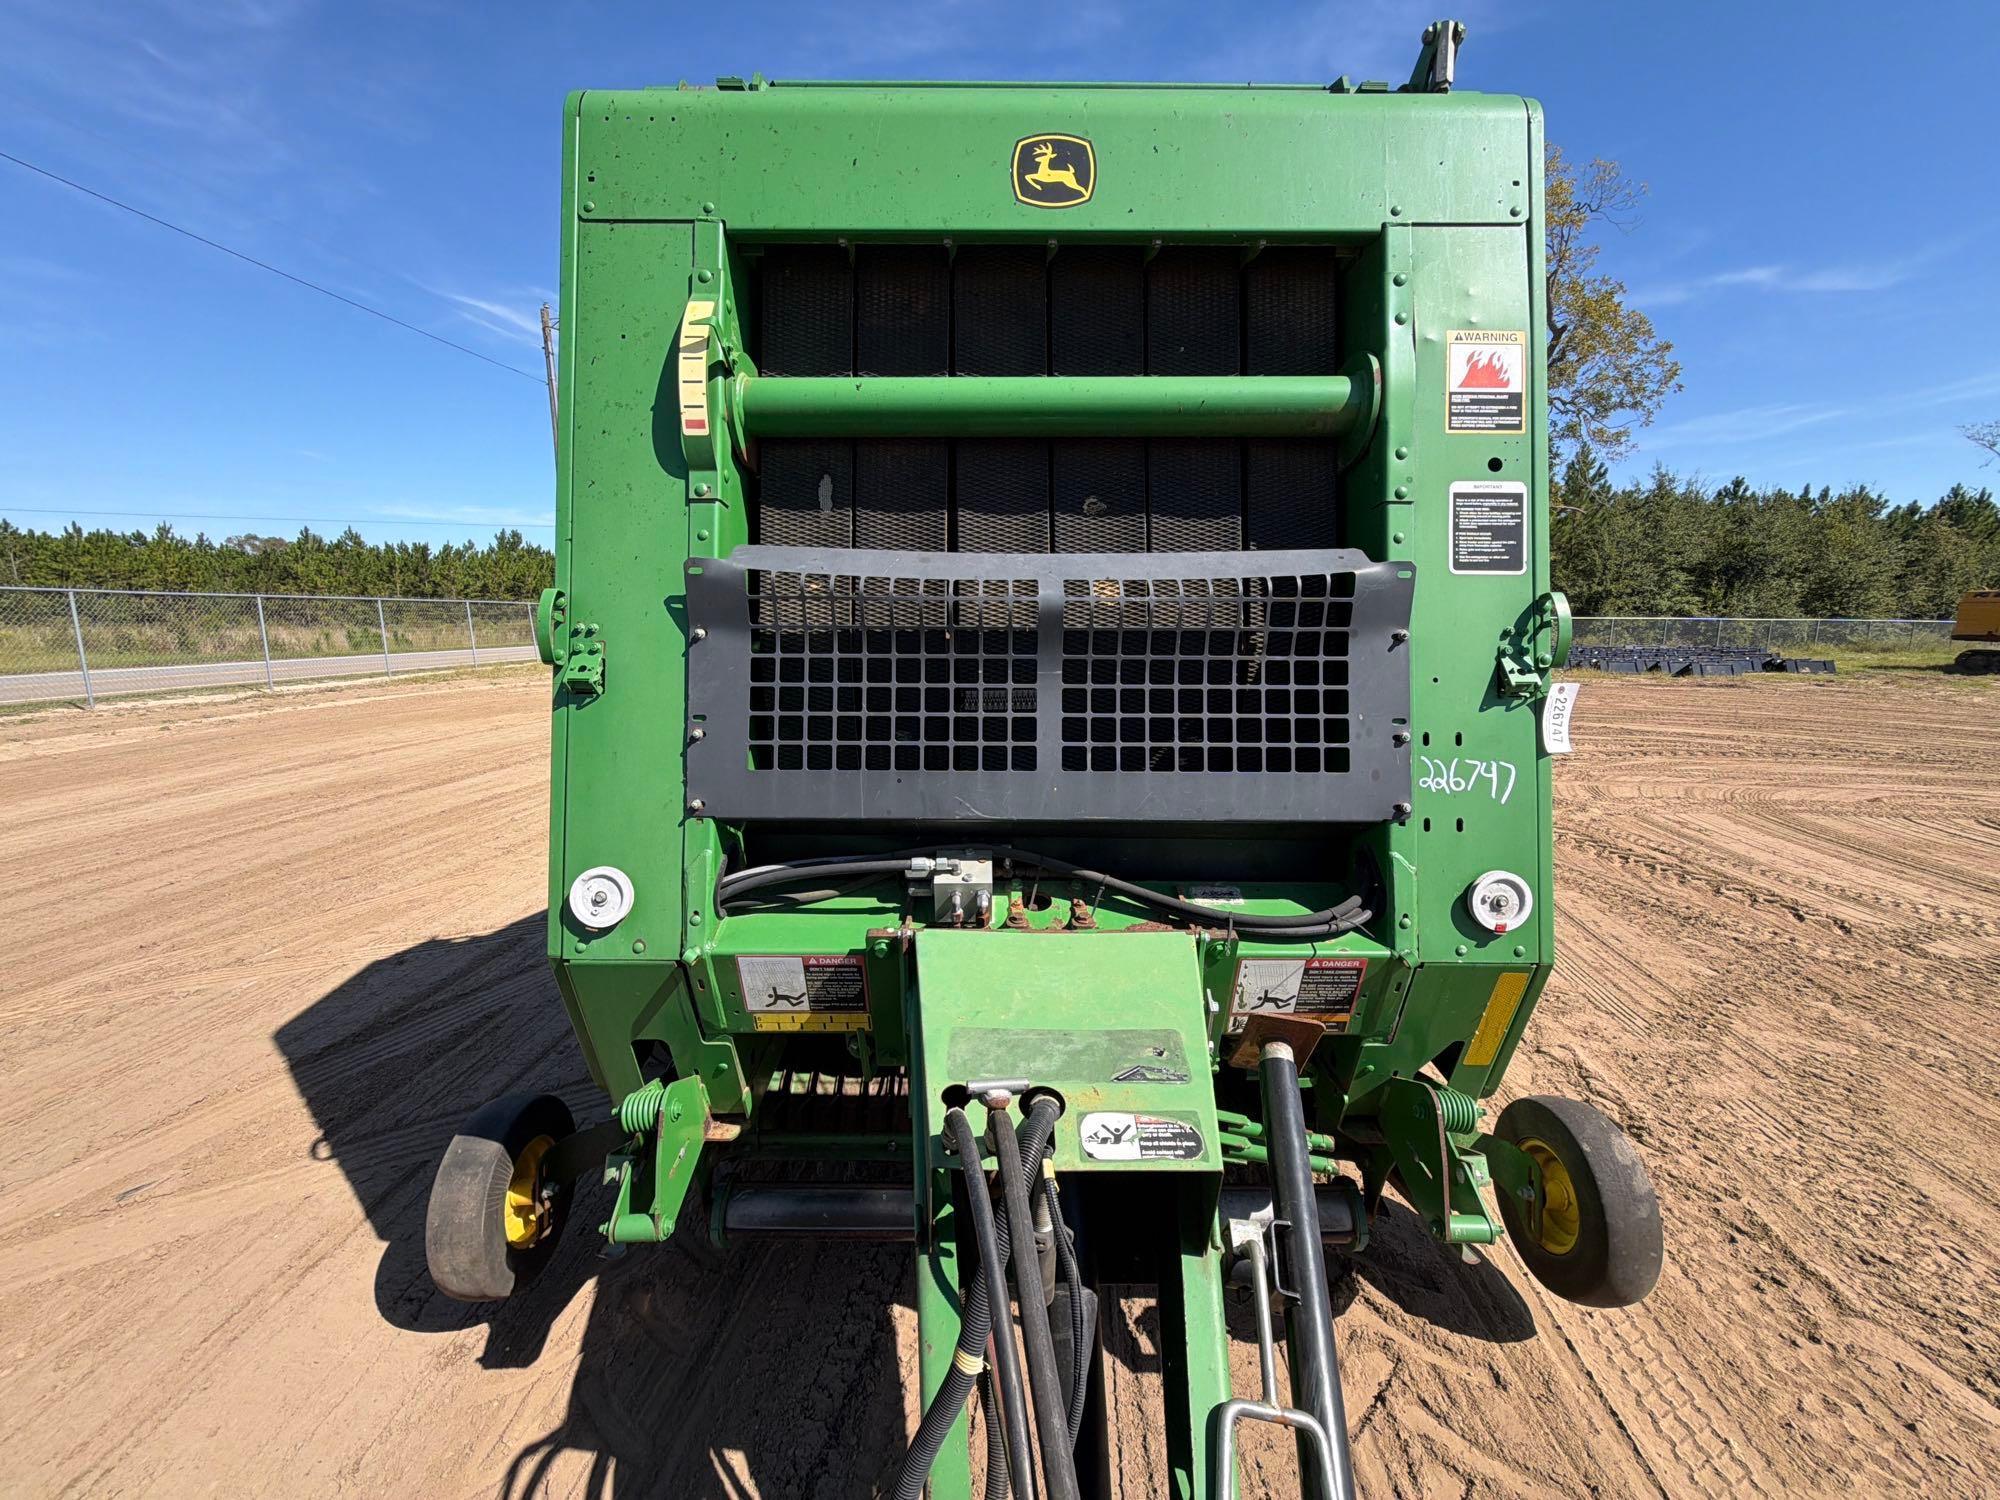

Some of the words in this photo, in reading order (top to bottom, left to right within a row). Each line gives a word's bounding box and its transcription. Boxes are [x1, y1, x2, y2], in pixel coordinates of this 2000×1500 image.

[1464, 332, 1518, 342] WARNING
[1552, 697, 1567, 743] 226747
[1419, 755, 1516, 805] 226747
[819, 957, 857, 965] DANGER
